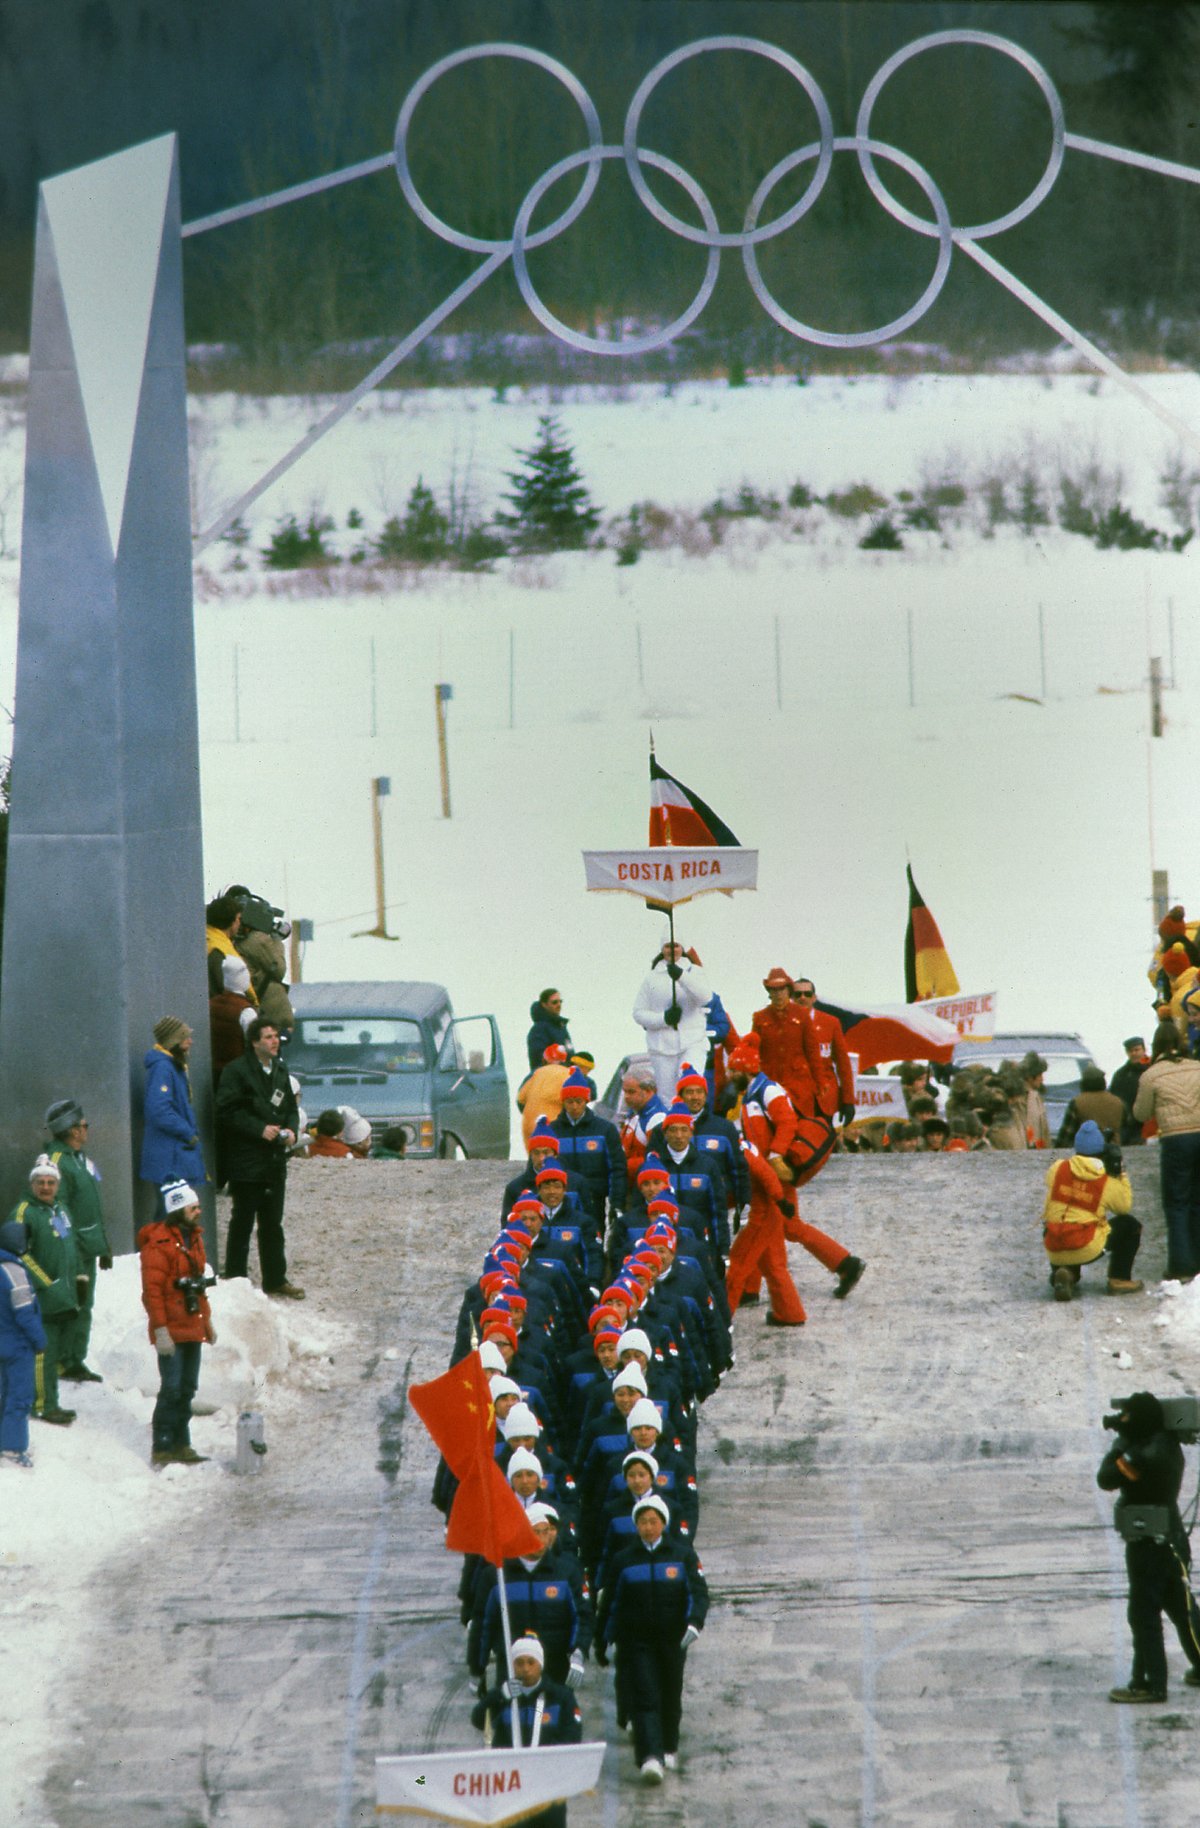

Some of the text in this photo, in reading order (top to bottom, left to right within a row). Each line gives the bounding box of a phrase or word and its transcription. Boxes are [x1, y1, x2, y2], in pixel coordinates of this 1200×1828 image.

[618, 860, 721, 881] COSTA RICA
[935, 995, 992, 1020] REPUBLIC
[453, 1768, 522, 1797] CHINA
